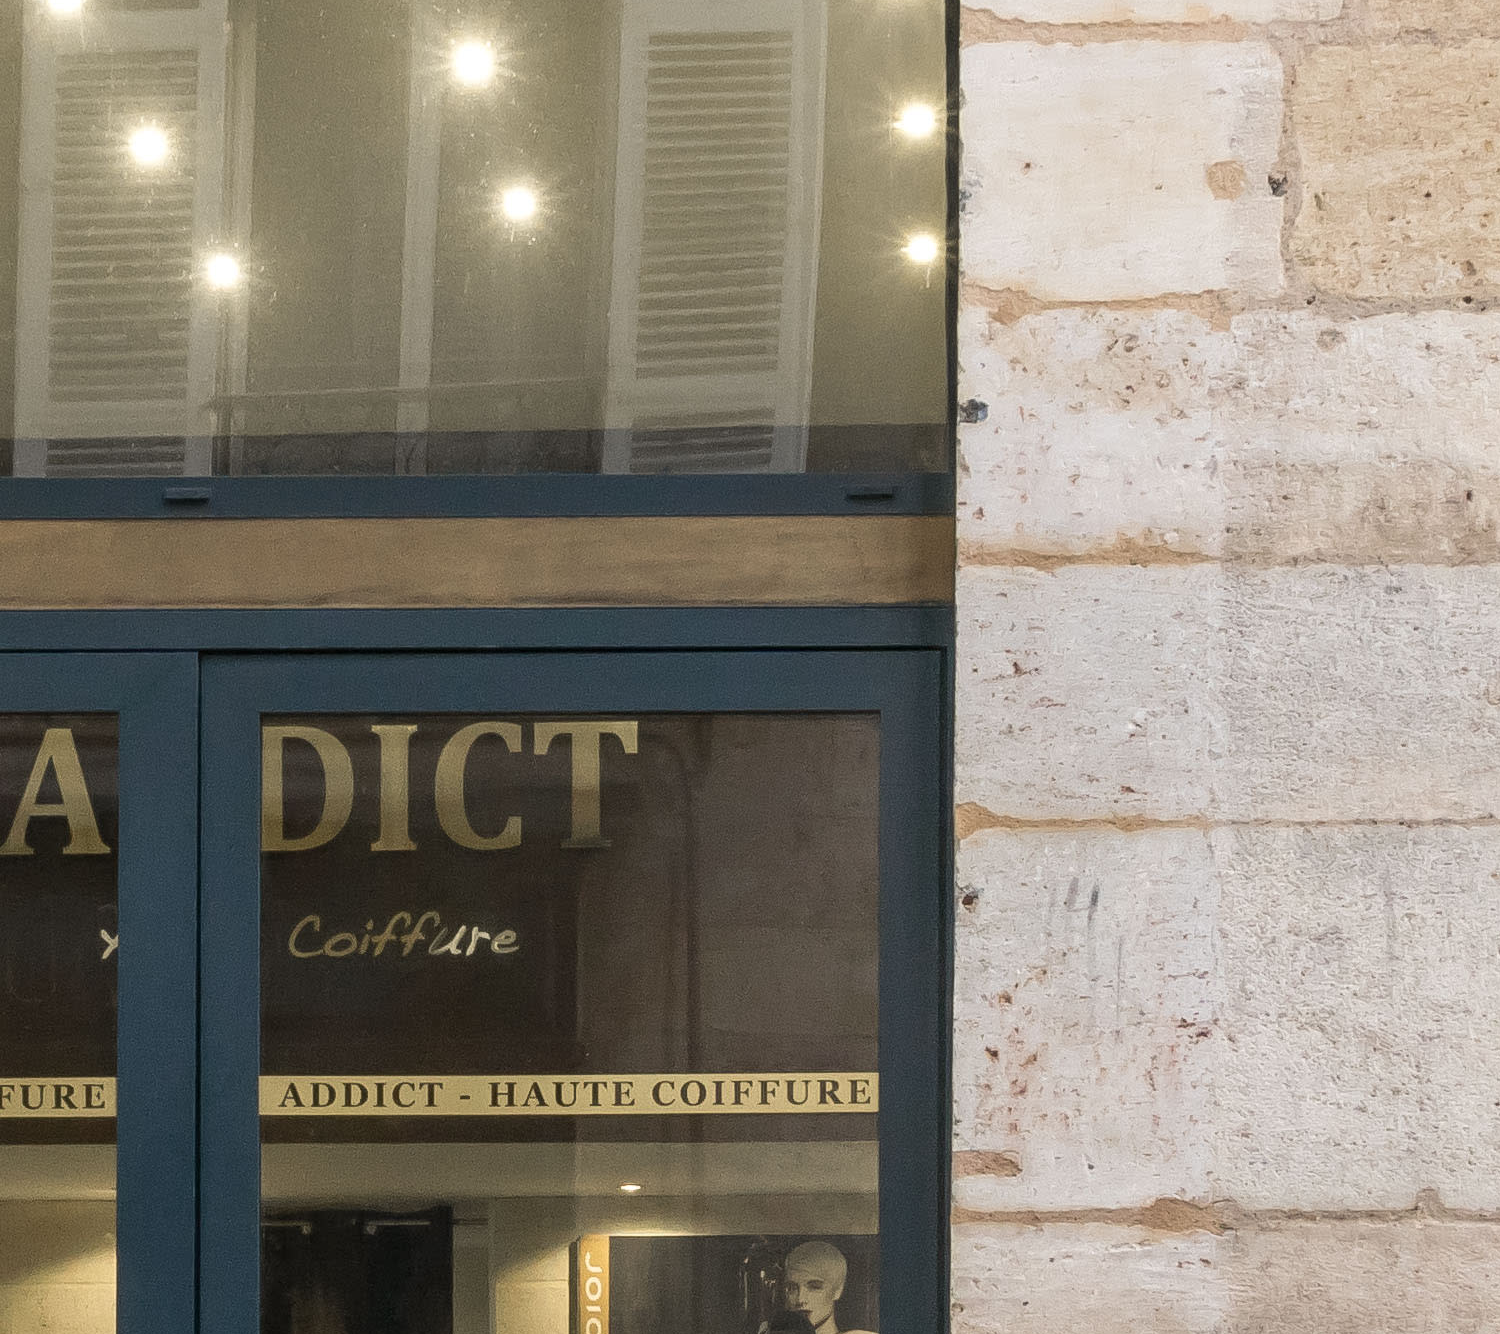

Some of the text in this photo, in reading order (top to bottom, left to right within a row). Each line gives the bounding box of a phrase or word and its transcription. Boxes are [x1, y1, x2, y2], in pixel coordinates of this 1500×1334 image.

[288, 910, 520, 960] Coiffure
[278, 1081, 444, 1108] ADDICT
[488, 1080, 635, 1107] HAUTE
[652, 1079, 872, 1106] COIFFURE
